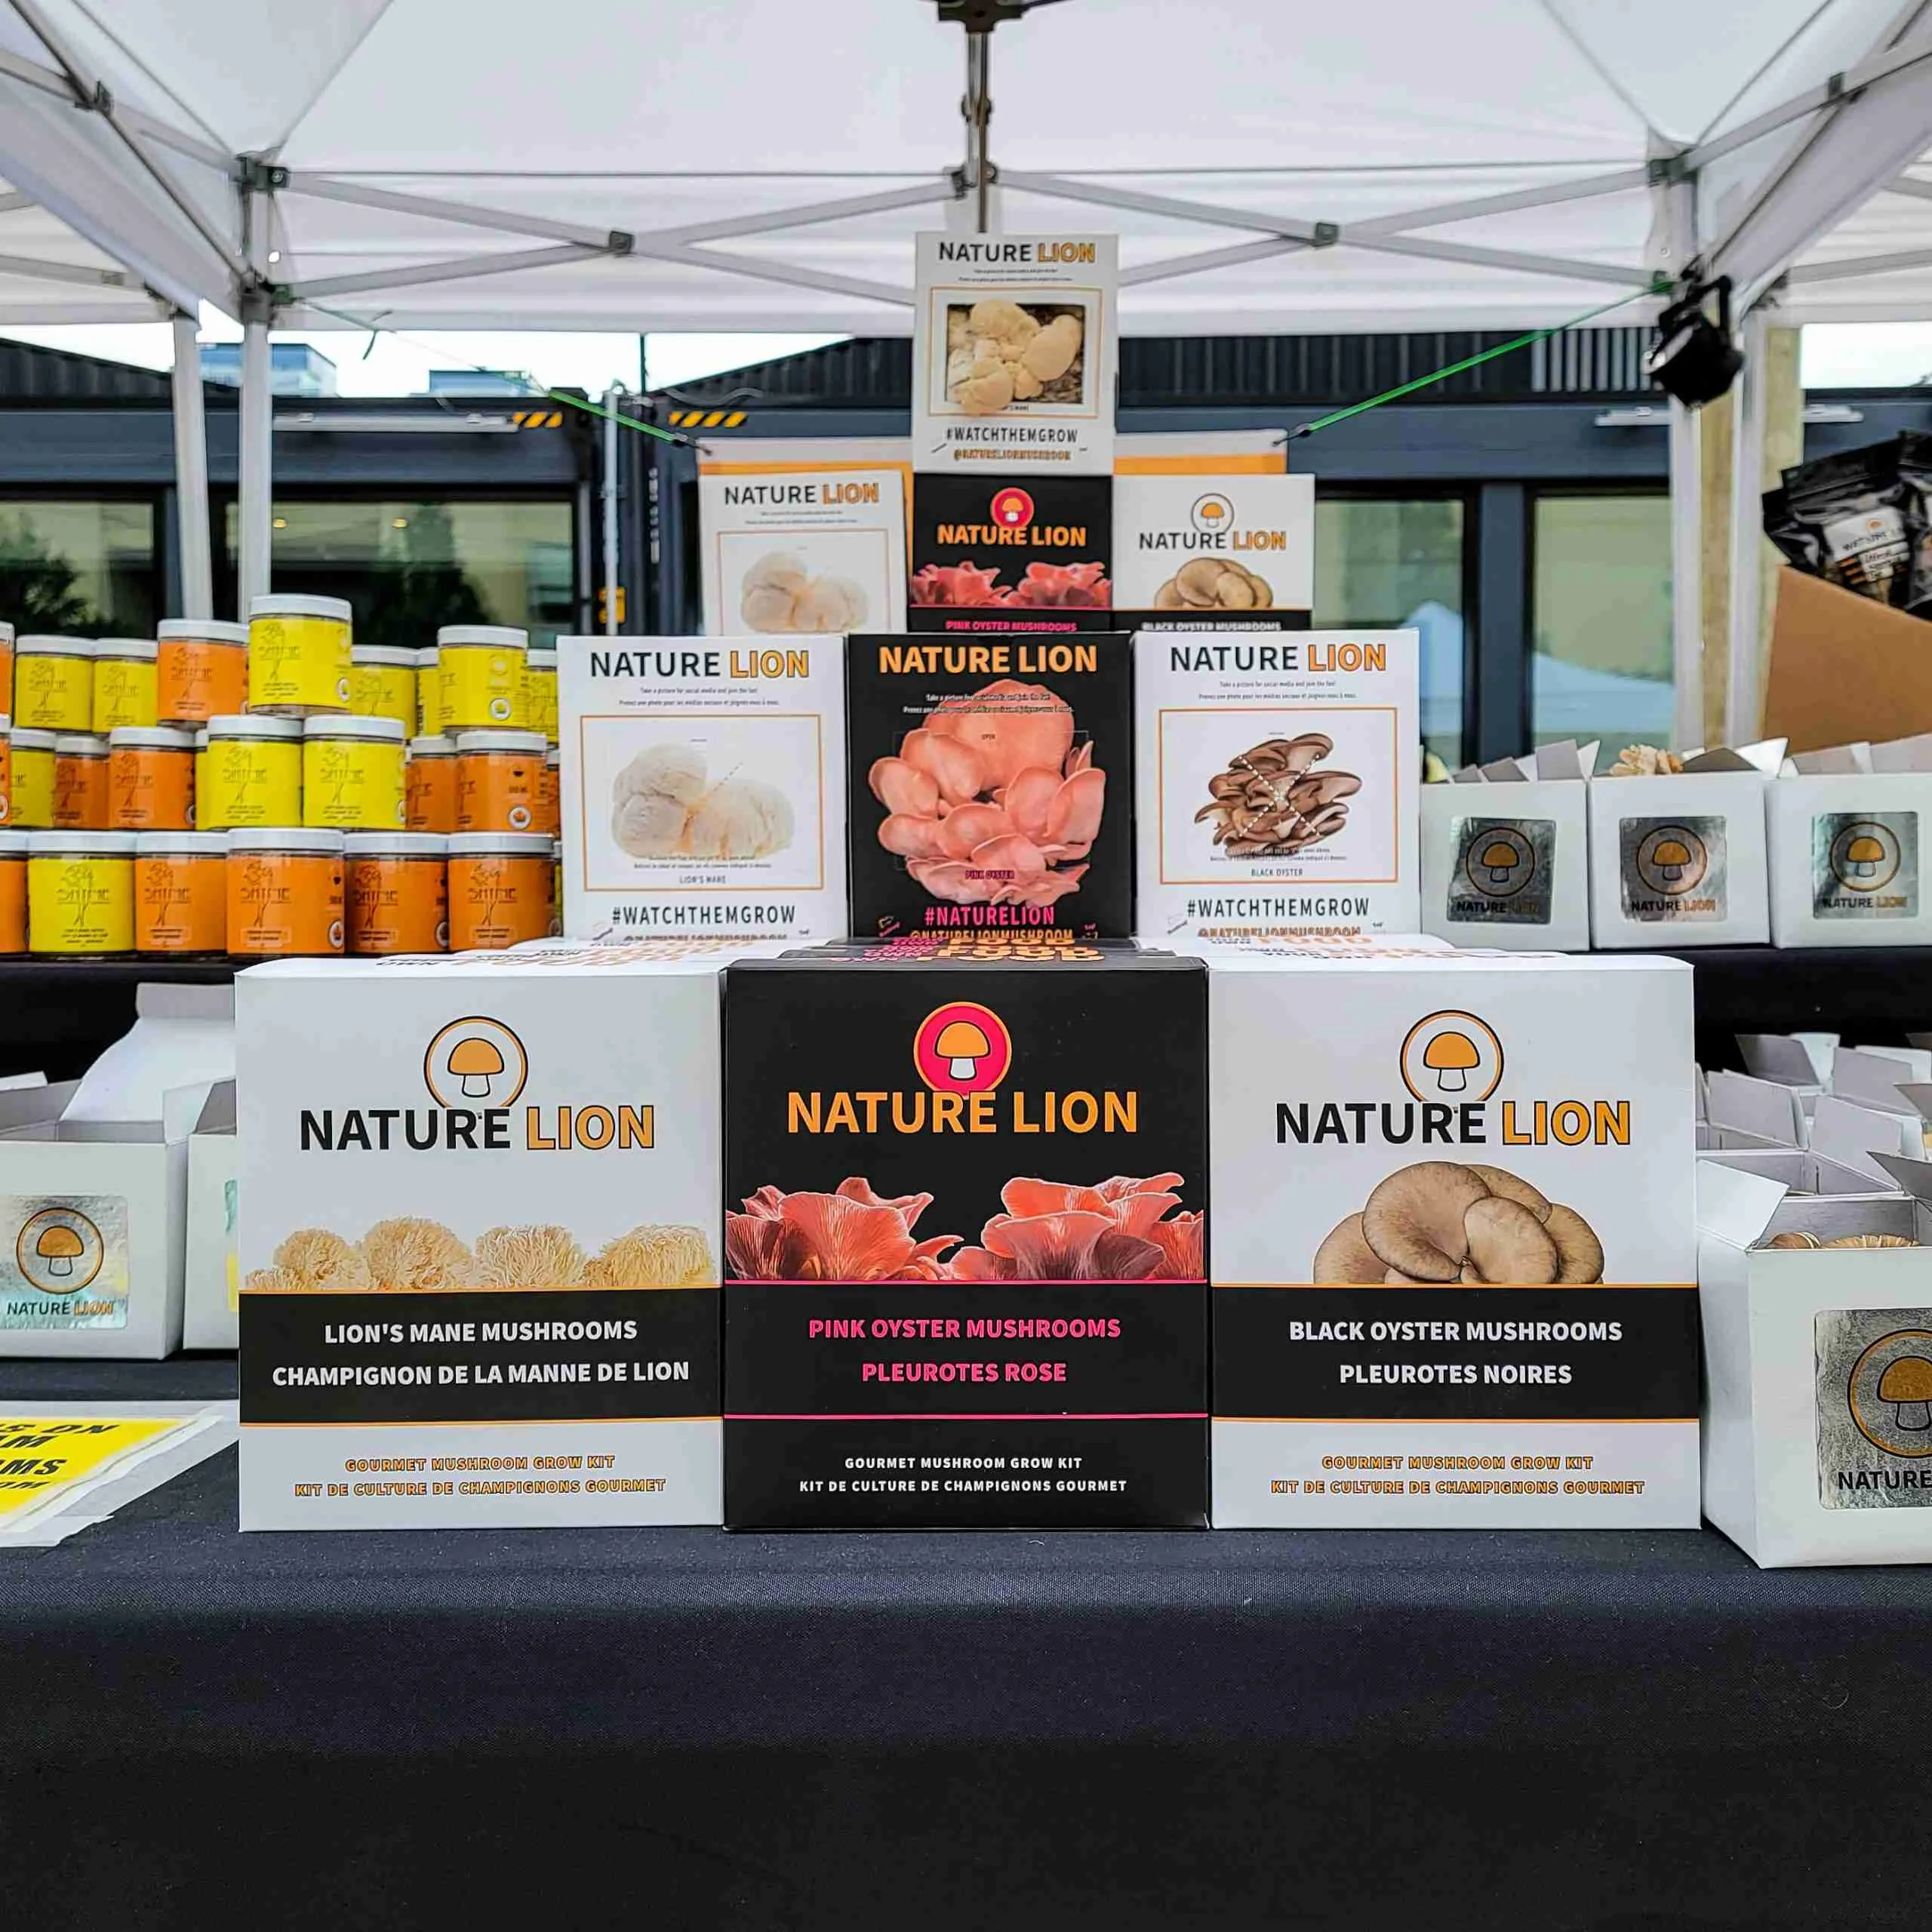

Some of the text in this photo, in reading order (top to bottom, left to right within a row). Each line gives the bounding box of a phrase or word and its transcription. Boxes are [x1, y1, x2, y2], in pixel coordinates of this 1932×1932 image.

[939, 242, 1095, 263] NATURE LION
[947, 427, 1078, 442] #WATCHTHEMGROW
[724, 483, 879, 505] NATURE LION
[937, 525, 1086, 546] NATURE LION
[1139, 531, 1286, 550] NATURE LION
[592, 650, 809, 678] NATURE LION
[880, 645, 1097, 672] NATURE LION
[1171, 644, 1386, 672] NATURE LION
[965, 869, 1014, 880] PINK OYSTER
[1251, 868, 1303, 876] BLACK OYSTER
[1187, 897, 1369, 918] #WATCHTHEMGROW
[1457, 901, 1506, 913] NATURE
[1632, 900, 1681, 912] NATURE
[1823, 897, 1873, 908] NATURE
[612, 905, 795, 925] #WATCHTHEMGROW
[924, 906, 1055, 926] #NATURELION
[788, 1091, 1137, 1134] NATURE LION
[300, 1105, 655, 1150] NATURE LION
[1276, 1100, 1631, 1146] NATURE LION
[8, 1302, 70, 1315] NATURE
[325, 1321, 637, 1343] LION'S MANE MUSHROOMS
[810, 1319, 1120, 1338] PINK OYSTER MUSHROOMS
[1291, 1322, 1622, 1340] BLACK OYSTER MUSHROOMS
[273, 1361, 688, 1386] CHAMPIGNON DE LA MANNE DE LION
[863, 1363, 1066, 1381] PLEUROTES ROSE
[1340, 1365, 1572, 1383] PLEUROTES NOIRES
[42, 1424, 120, 1434] ON
[0, 1459, 67, 1475] MS
[346, 1456, 615, 1472] GOURMET MUSHROOM GROW KIT
[845, 1457, 1081, 1469] GOURMET MUSHROOM GROW KIT
[1322, 1457, 1593, 1469] GOURMET MUSHROOM GROW KIT
[295, 1479, 666, 1497] KIT DE CULTURE DE CHAMPIGNONS GOURMET
[800, 1481, 1127, 1491] KIT DE CULTURE DE CHAMPIGNONS GOURMET
[1272, 1481, 1644, 1494] KIT DE CULTURE DE CHAMPIGNONS GOURMET
[1838, 1471, 1932, 1490] NATURE
